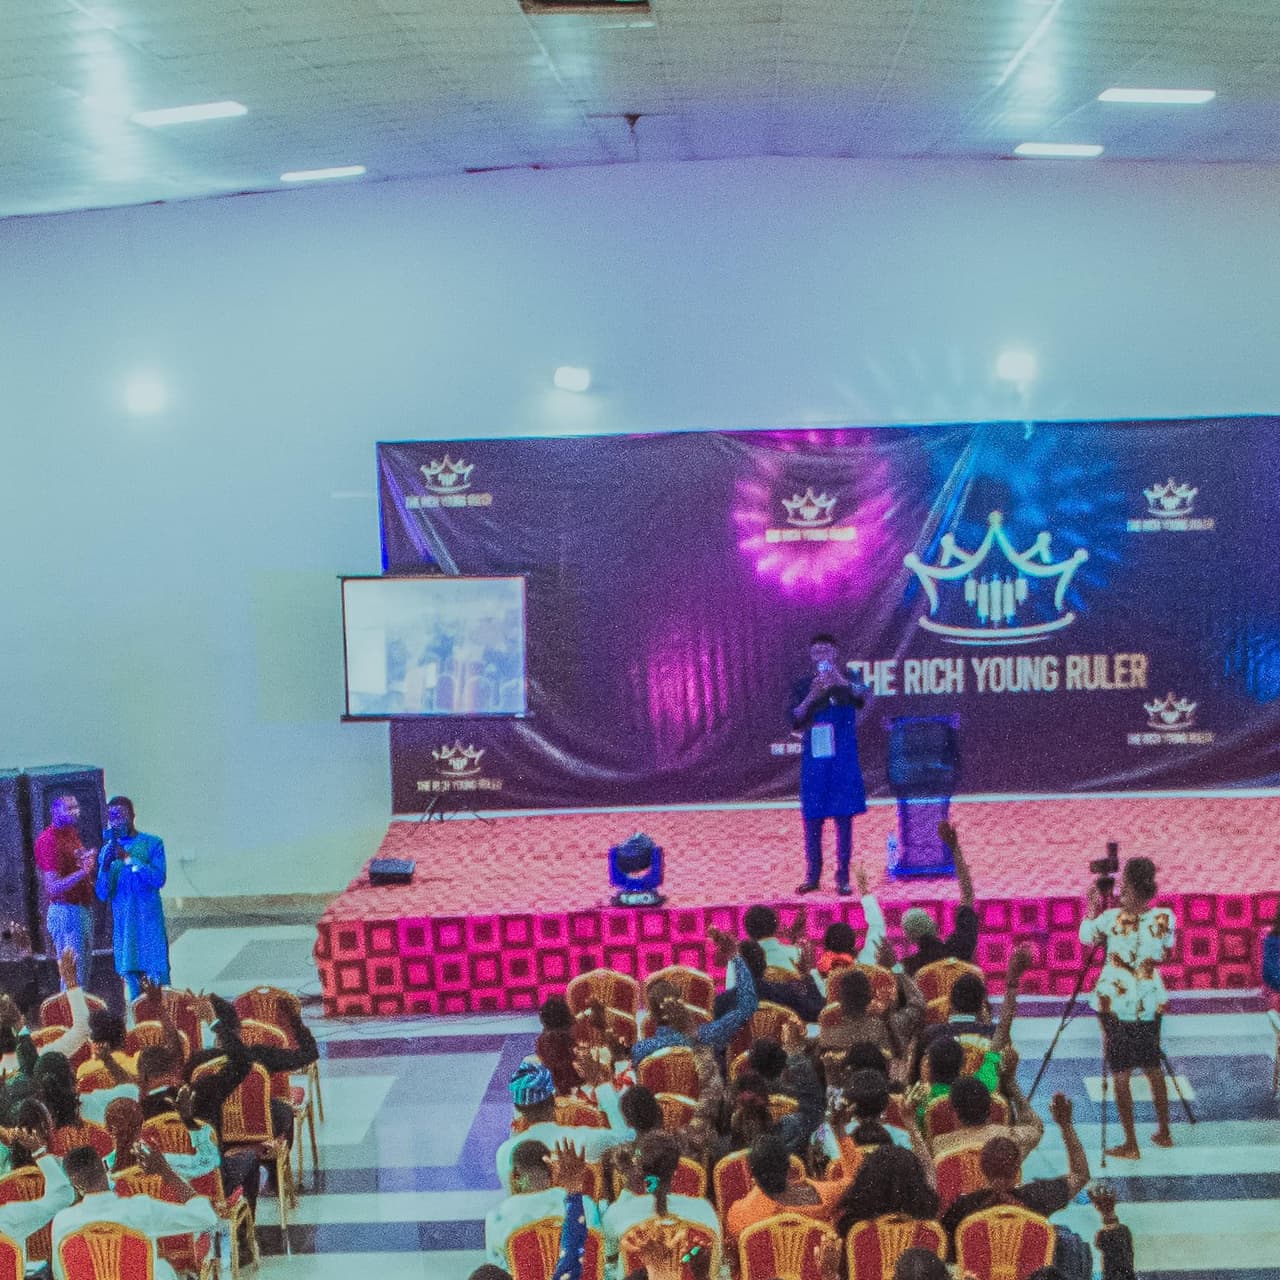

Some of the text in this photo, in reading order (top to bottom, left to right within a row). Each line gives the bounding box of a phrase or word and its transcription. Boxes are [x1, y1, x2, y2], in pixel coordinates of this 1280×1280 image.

[846, 653, 1149, 696] THE RICH YOUNG RULER
